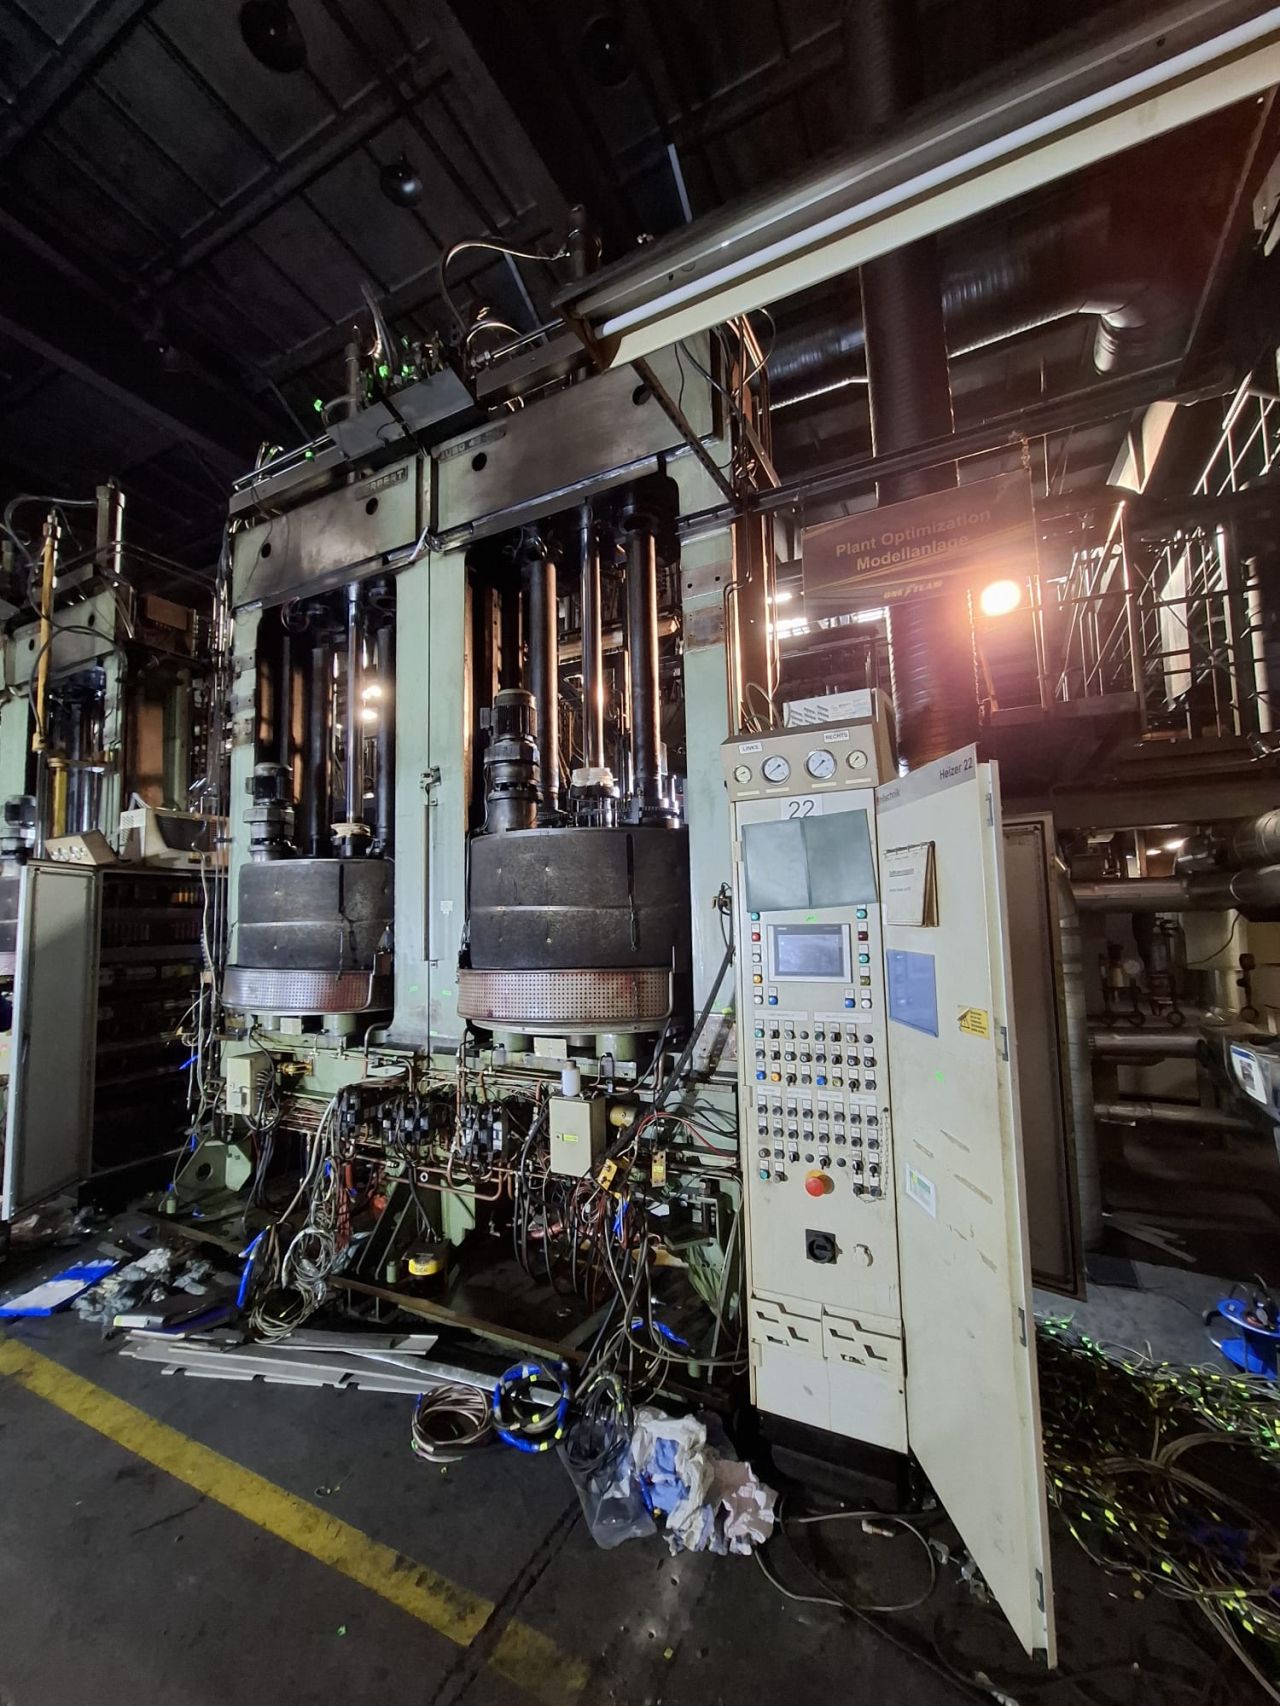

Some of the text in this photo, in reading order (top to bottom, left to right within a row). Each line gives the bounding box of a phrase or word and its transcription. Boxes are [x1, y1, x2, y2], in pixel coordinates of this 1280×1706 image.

[836, 510, 991, 558] Plant Optimization
[857, 535, 969, 571] Modellanlage
[939, 757, 974, 780] Heizer 22
[788, 799, 815, 819] 22
